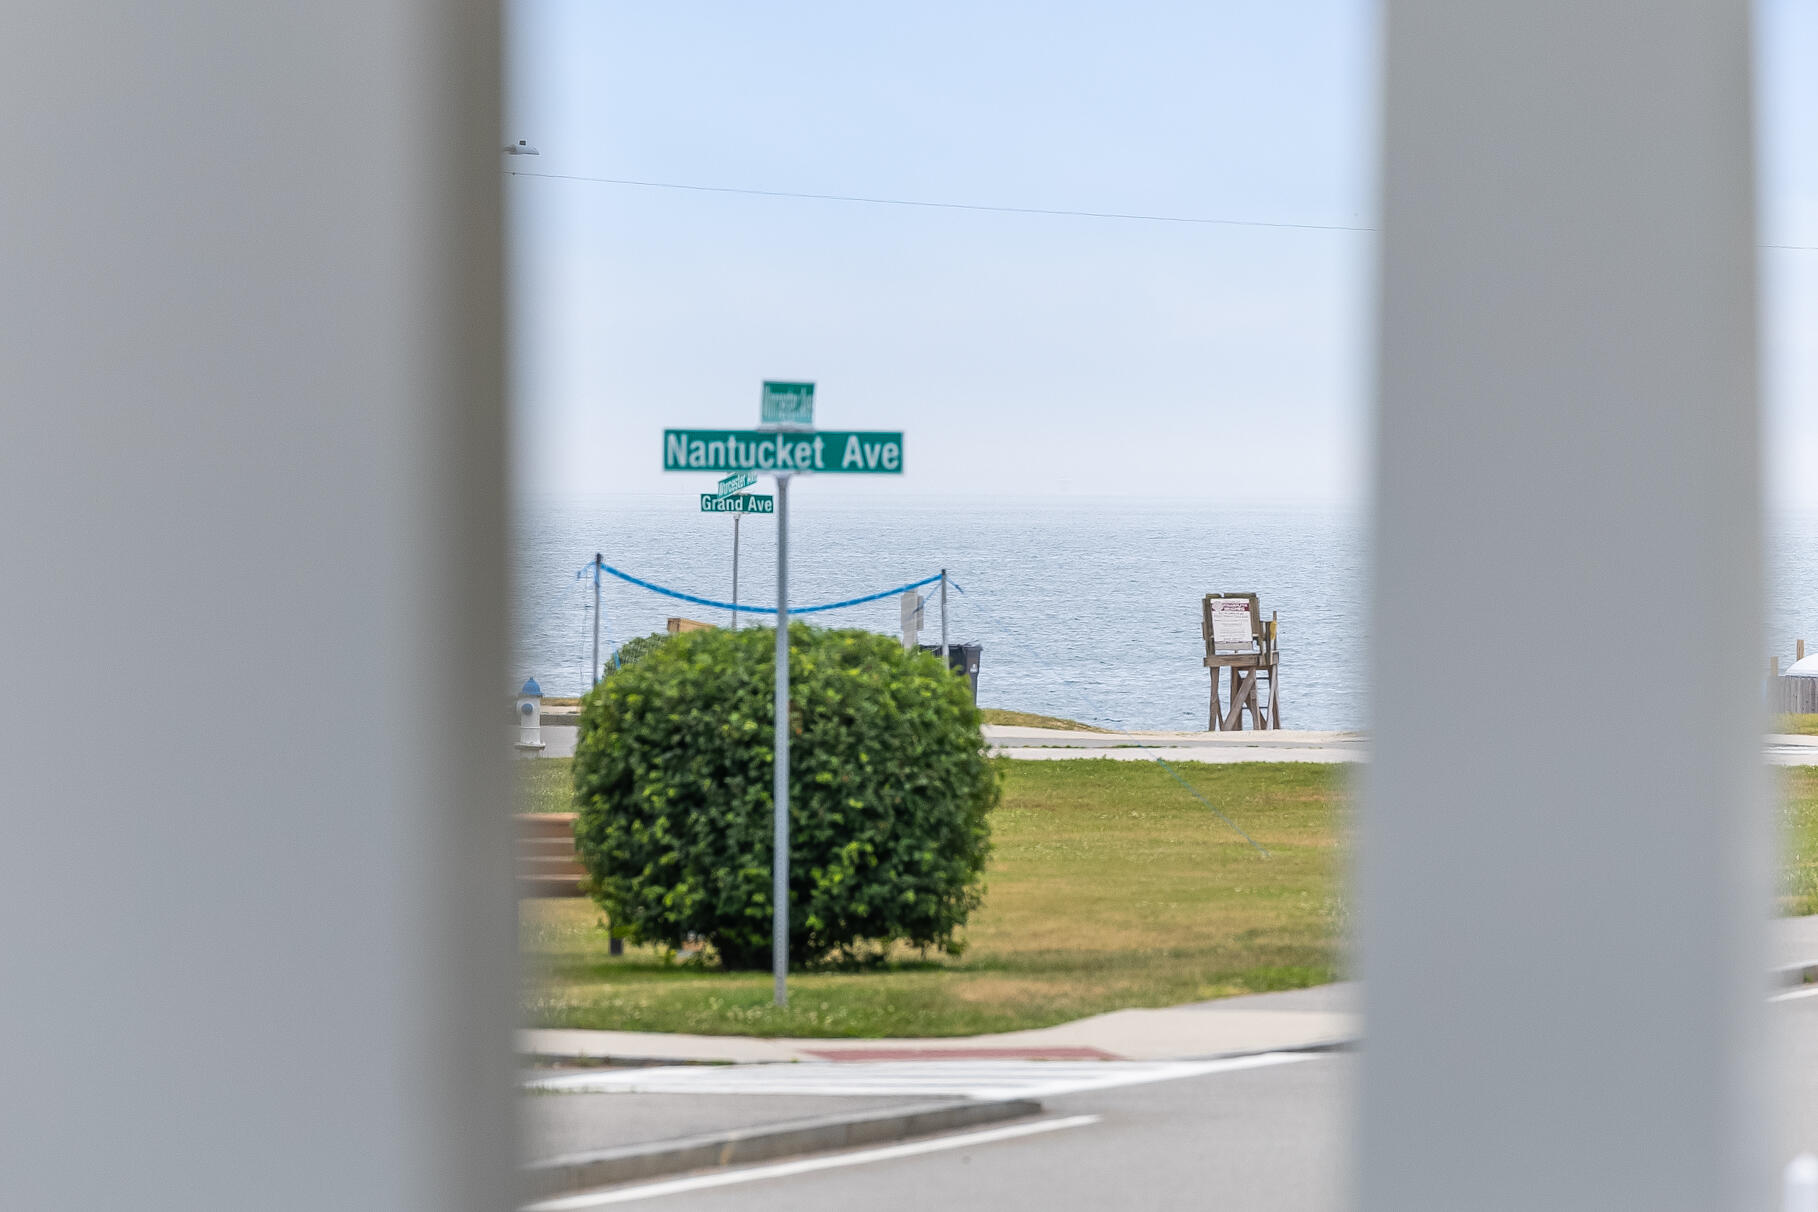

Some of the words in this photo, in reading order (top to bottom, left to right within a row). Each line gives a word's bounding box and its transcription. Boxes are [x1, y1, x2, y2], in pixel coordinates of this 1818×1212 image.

[666, 433, 825, 469] Nantucket
[841, 435, 900, 470] Ave
[702, 495, 743, 511] Grand
[748, 496, 772, 512] Ave
